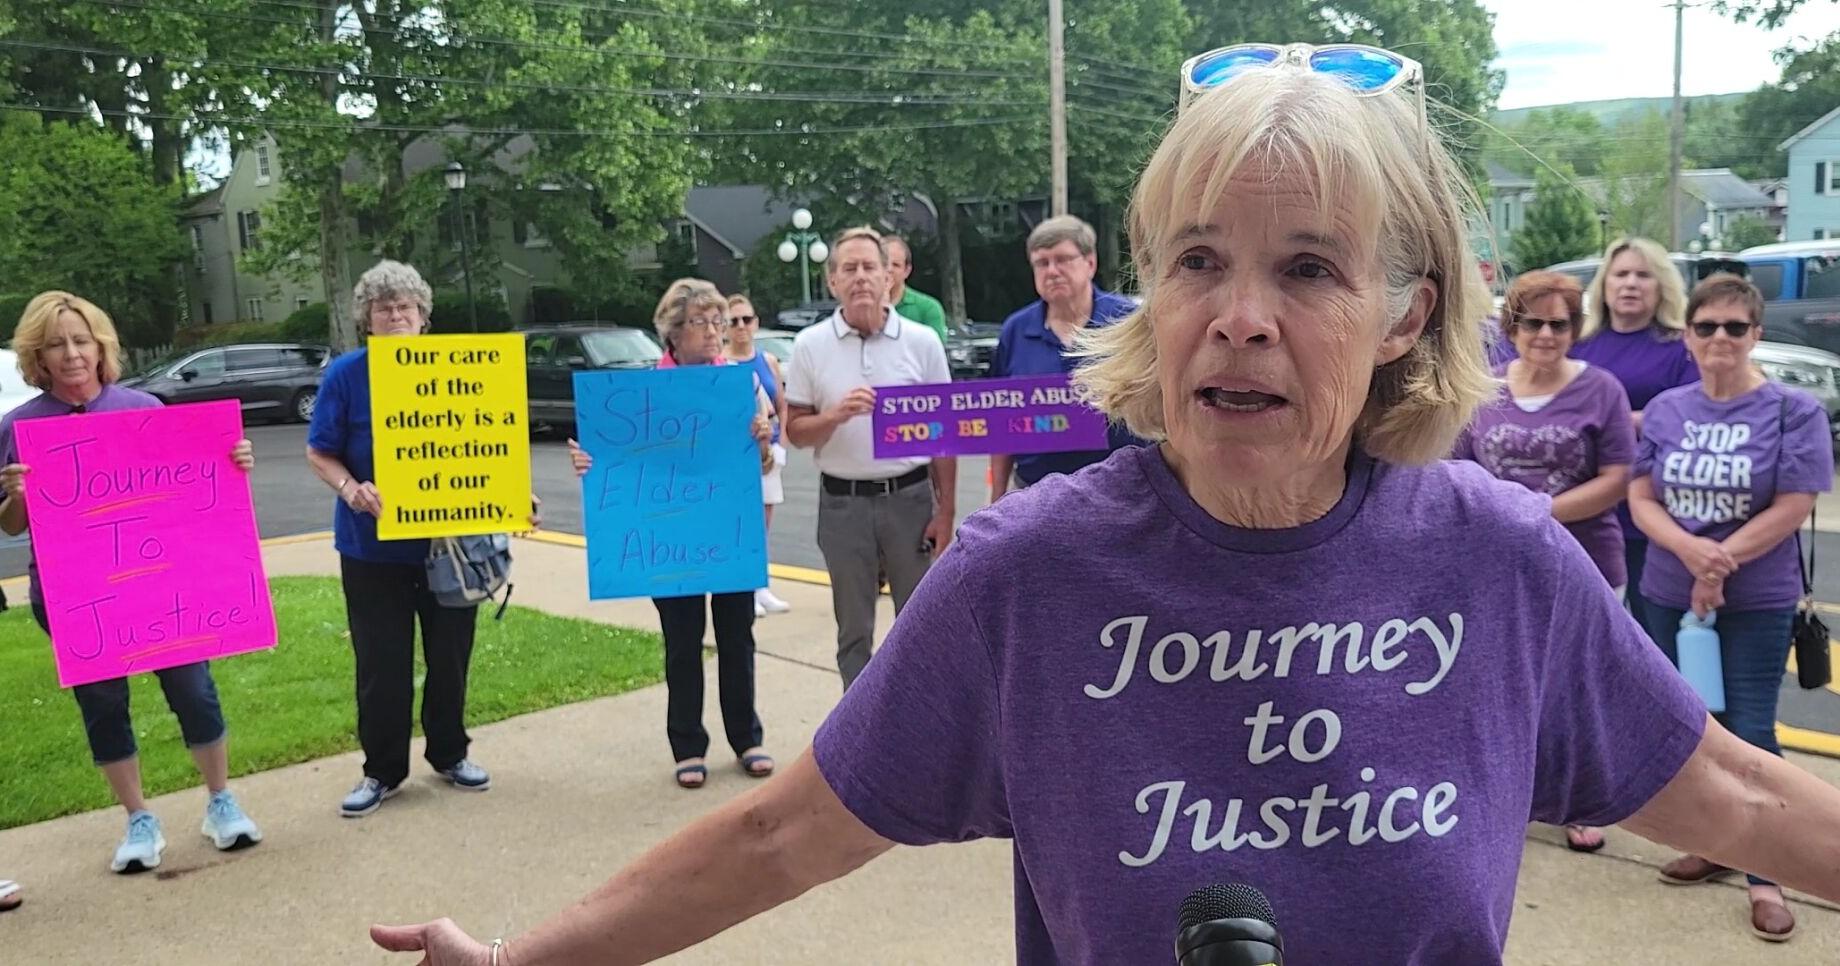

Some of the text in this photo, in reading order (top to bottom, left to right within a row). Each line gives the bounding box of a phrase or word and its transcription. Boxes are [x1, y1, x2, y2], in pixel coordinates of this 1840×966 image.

[395, 347, 500, 366] Our care
[416, 377, 484, 396] of the
[881, 384, 1090, 415] STOP ELDER ABUS
[385, 408, 516, 431] elderly is a
[594, 387, 713, 463] Stop
[957, 418, 988, 437] BE
[1680, 419, 1751, 453] STOP
[396, 439, 509, 461] reflection
[39, 437, 217, 512] Journey
[418, 472, 490, 491] of our
[599, 460, 726, 513] Elder
[1662, 451, 1753, 489] ELDER
[396, 501, 514, 524] humanity.
[1663, 485, 1753, 524] ABUSE
[85, 515, 164, 568] To
[620, 515, 744, 573] Abuse!
[66, 571, 260, 661] Justice!
[1083, 612, 1464, 699] Journey
[1242, 700, 1342, 765] to
[1117, 766, 1460, 868] Justice
